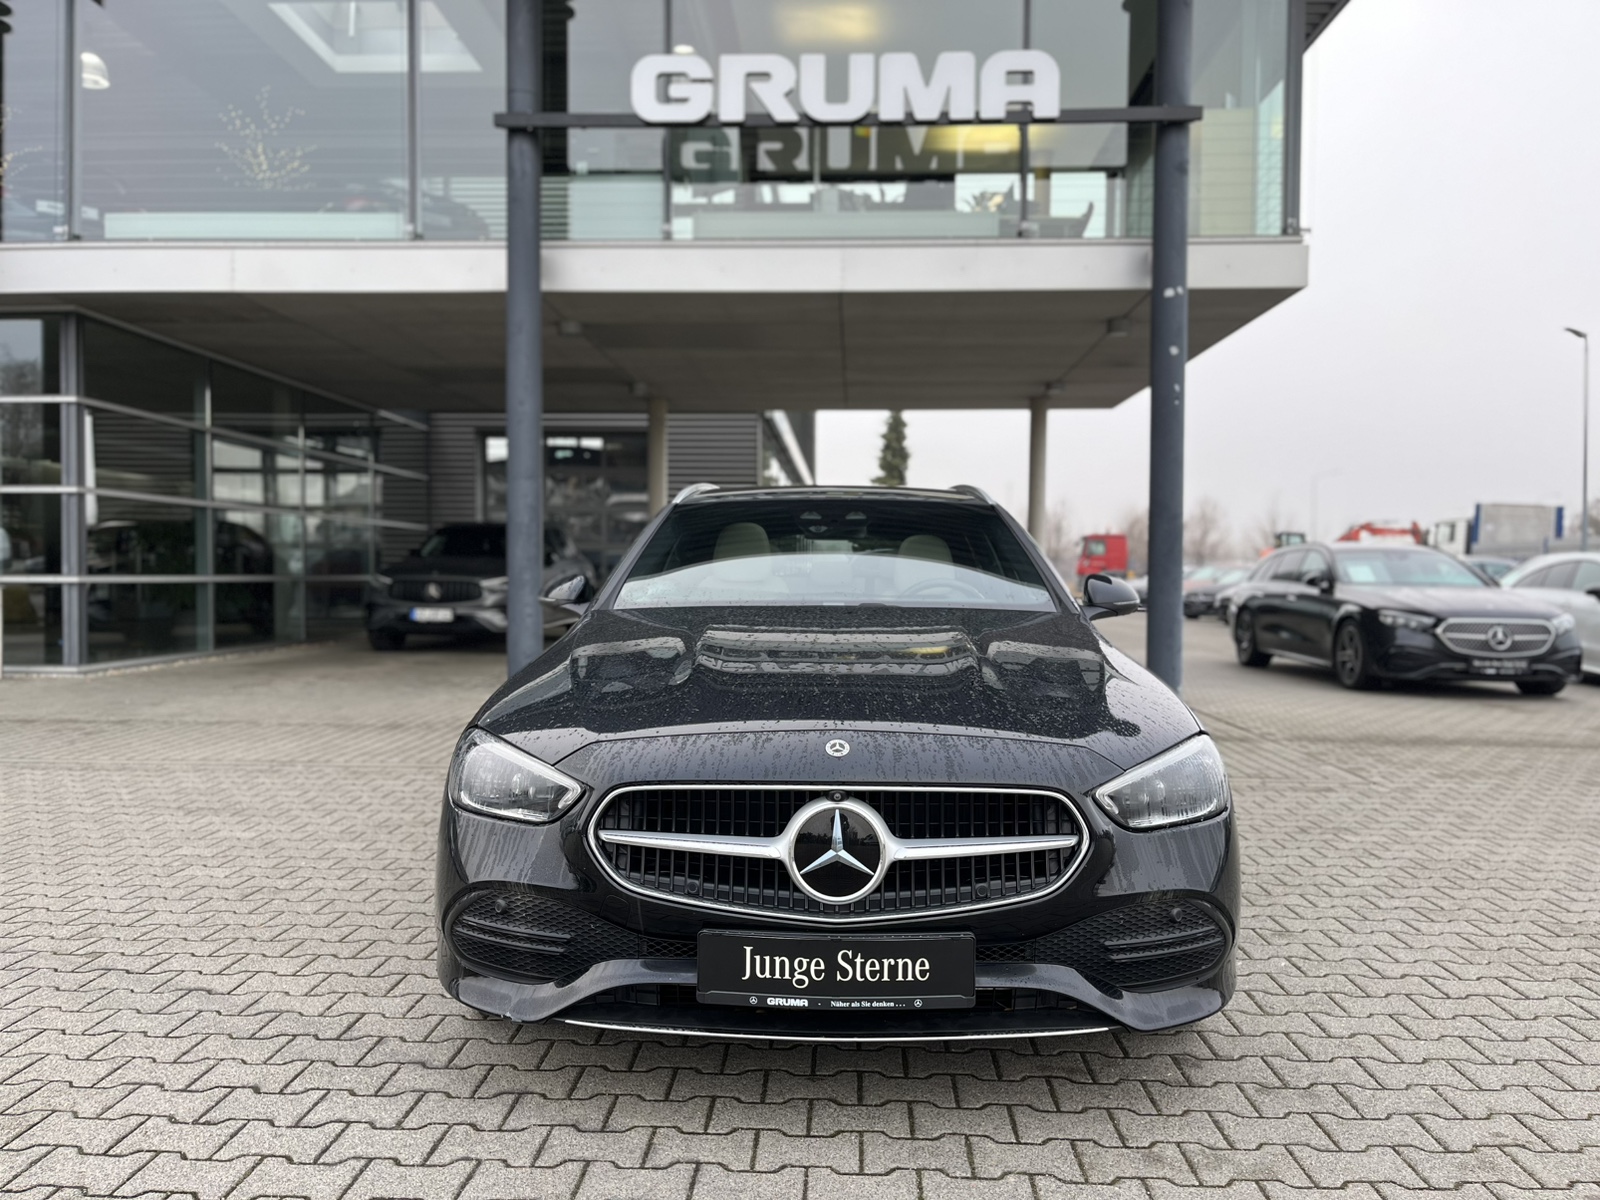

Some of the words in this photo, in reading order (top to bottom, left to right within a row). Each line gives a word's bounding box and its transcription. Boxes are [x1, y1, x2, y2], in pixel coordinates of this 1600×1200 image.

[630, 50, 1061, 122] GRUMA
[741, 945, 826, 989] Junge
[836, 949, 931, 982] Sterne
[766, 996, 809, 1008] GRUMA
[830, 1000, 850, 1008] Näher
[851, 1000, 860, 1008] als
[861, 1000, 871, 1008] Sie
[872, 1000, 894, 1008] denken
